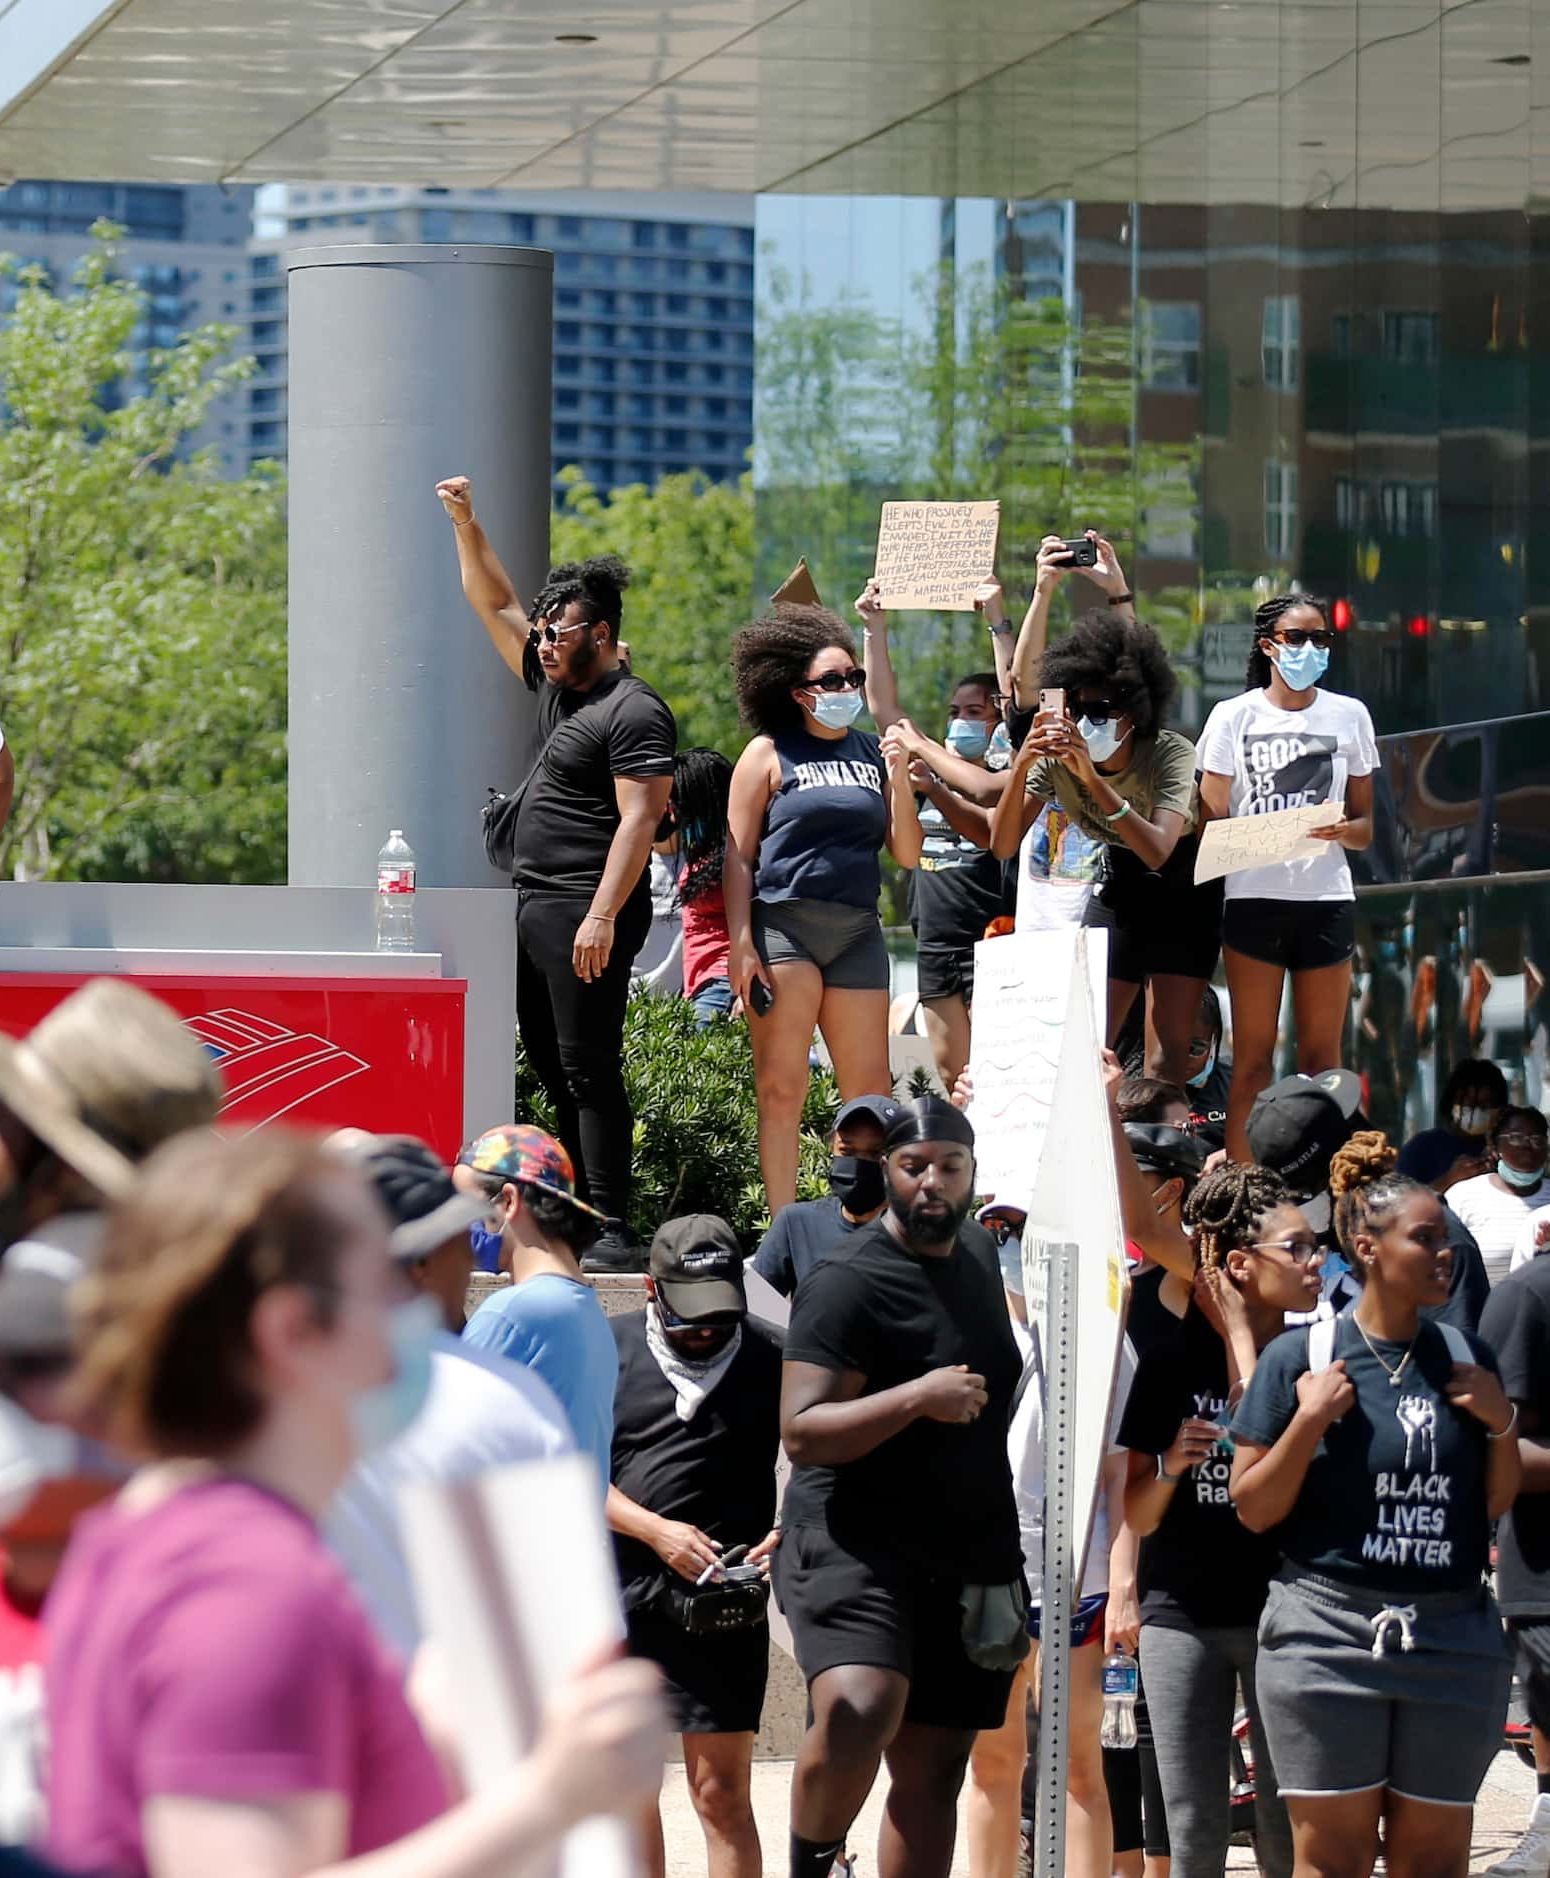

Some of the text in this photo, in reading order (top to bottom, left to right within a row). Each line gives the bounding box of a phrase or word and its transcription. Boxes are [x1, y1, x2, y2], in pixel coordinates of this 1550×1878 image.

[793, 760, 882, 795] HOWARD
[1255, 772, 1275, 796] IS
[1375, 1472, 1451, 1501] BLACK
[1377, 1503, 1446, 1535] LIVES
[1361, 1533, 1452, 1568] MATTER
